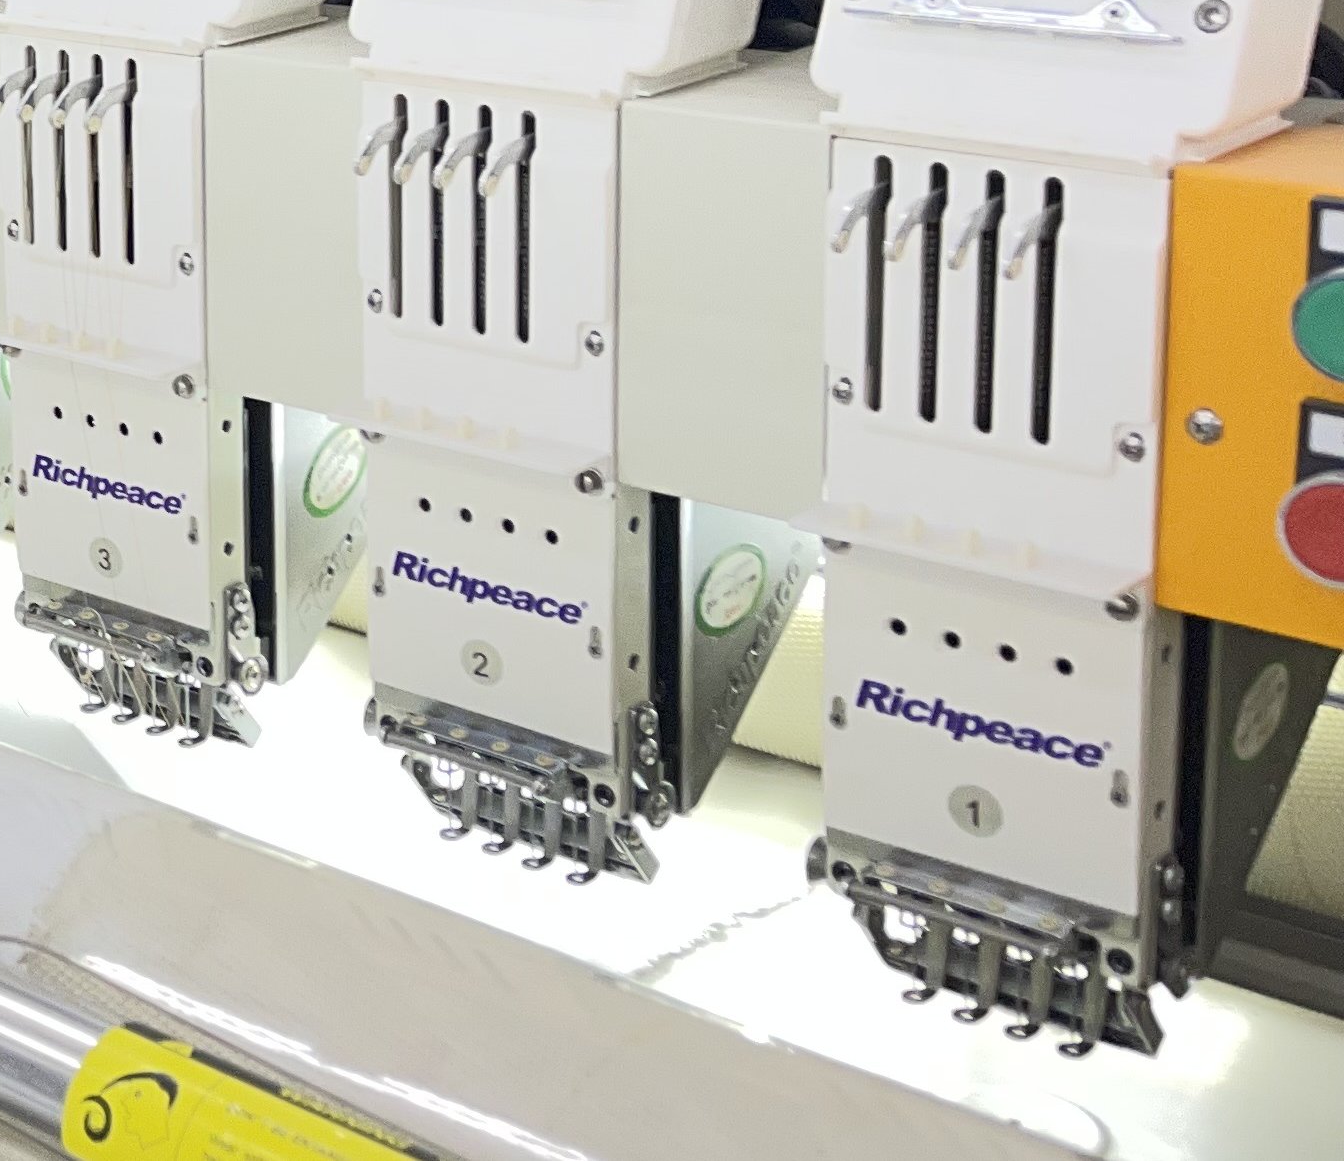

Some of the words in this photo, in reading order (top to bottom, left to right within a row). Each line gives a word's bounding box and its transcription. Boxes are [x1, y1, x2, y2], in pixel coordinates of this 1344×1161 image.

[32, 454, 184, 515] Richpeace
[98, 548, 111, 571] 3
[392, 551, 582, 624] Richpeace
[473, 652, 489, 678] 2
[855, 679, 1104, 768] Richpeace
[967, 800, 980, 828] 1
